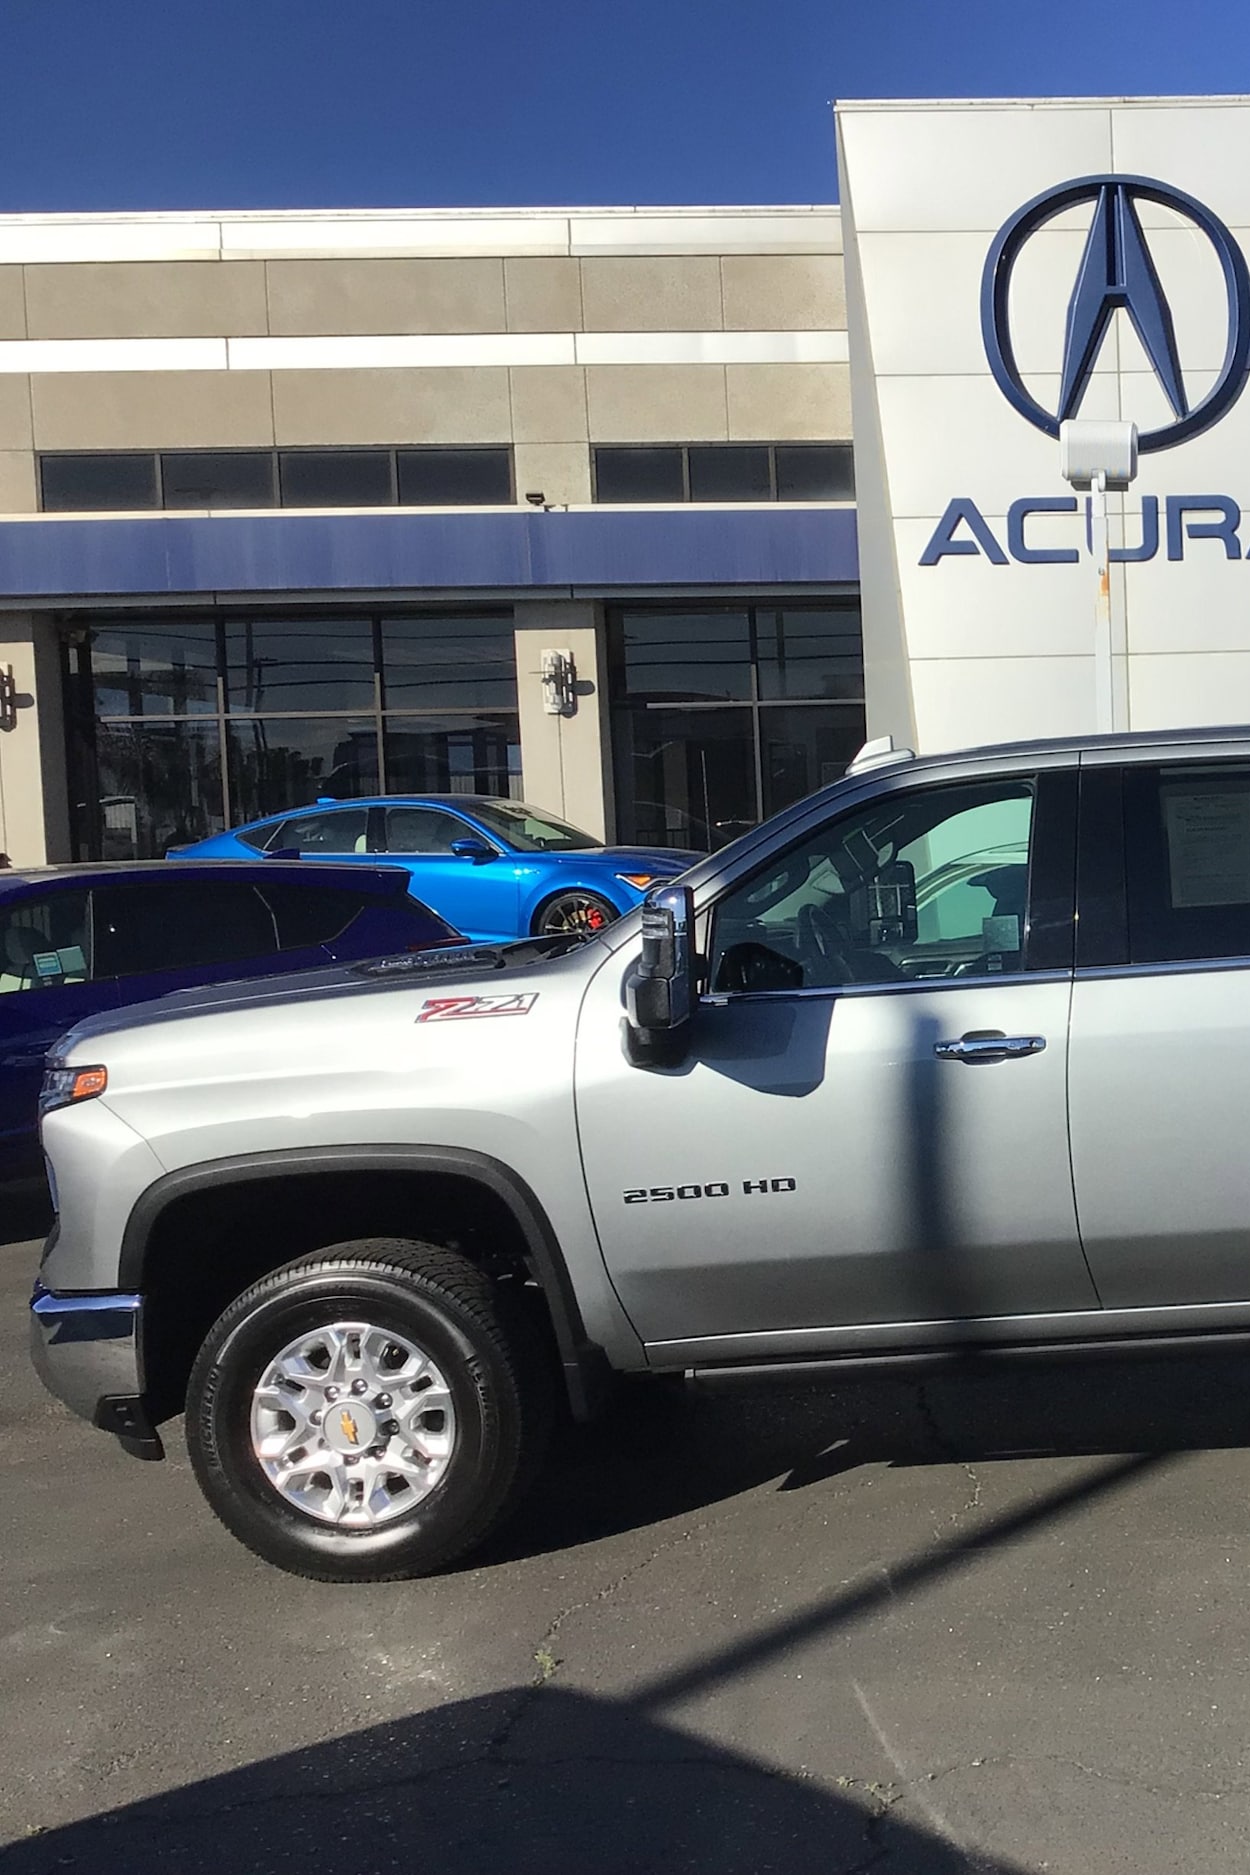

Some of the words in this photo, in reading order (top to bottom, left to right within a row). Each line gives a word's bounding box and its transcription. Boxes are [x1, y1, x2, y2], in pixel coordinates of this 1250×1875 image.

[415, 992, 540, 1024] Z71
[623, 1182, 729, 1204] 2500
[742, 1176, 797, 1195] HD
